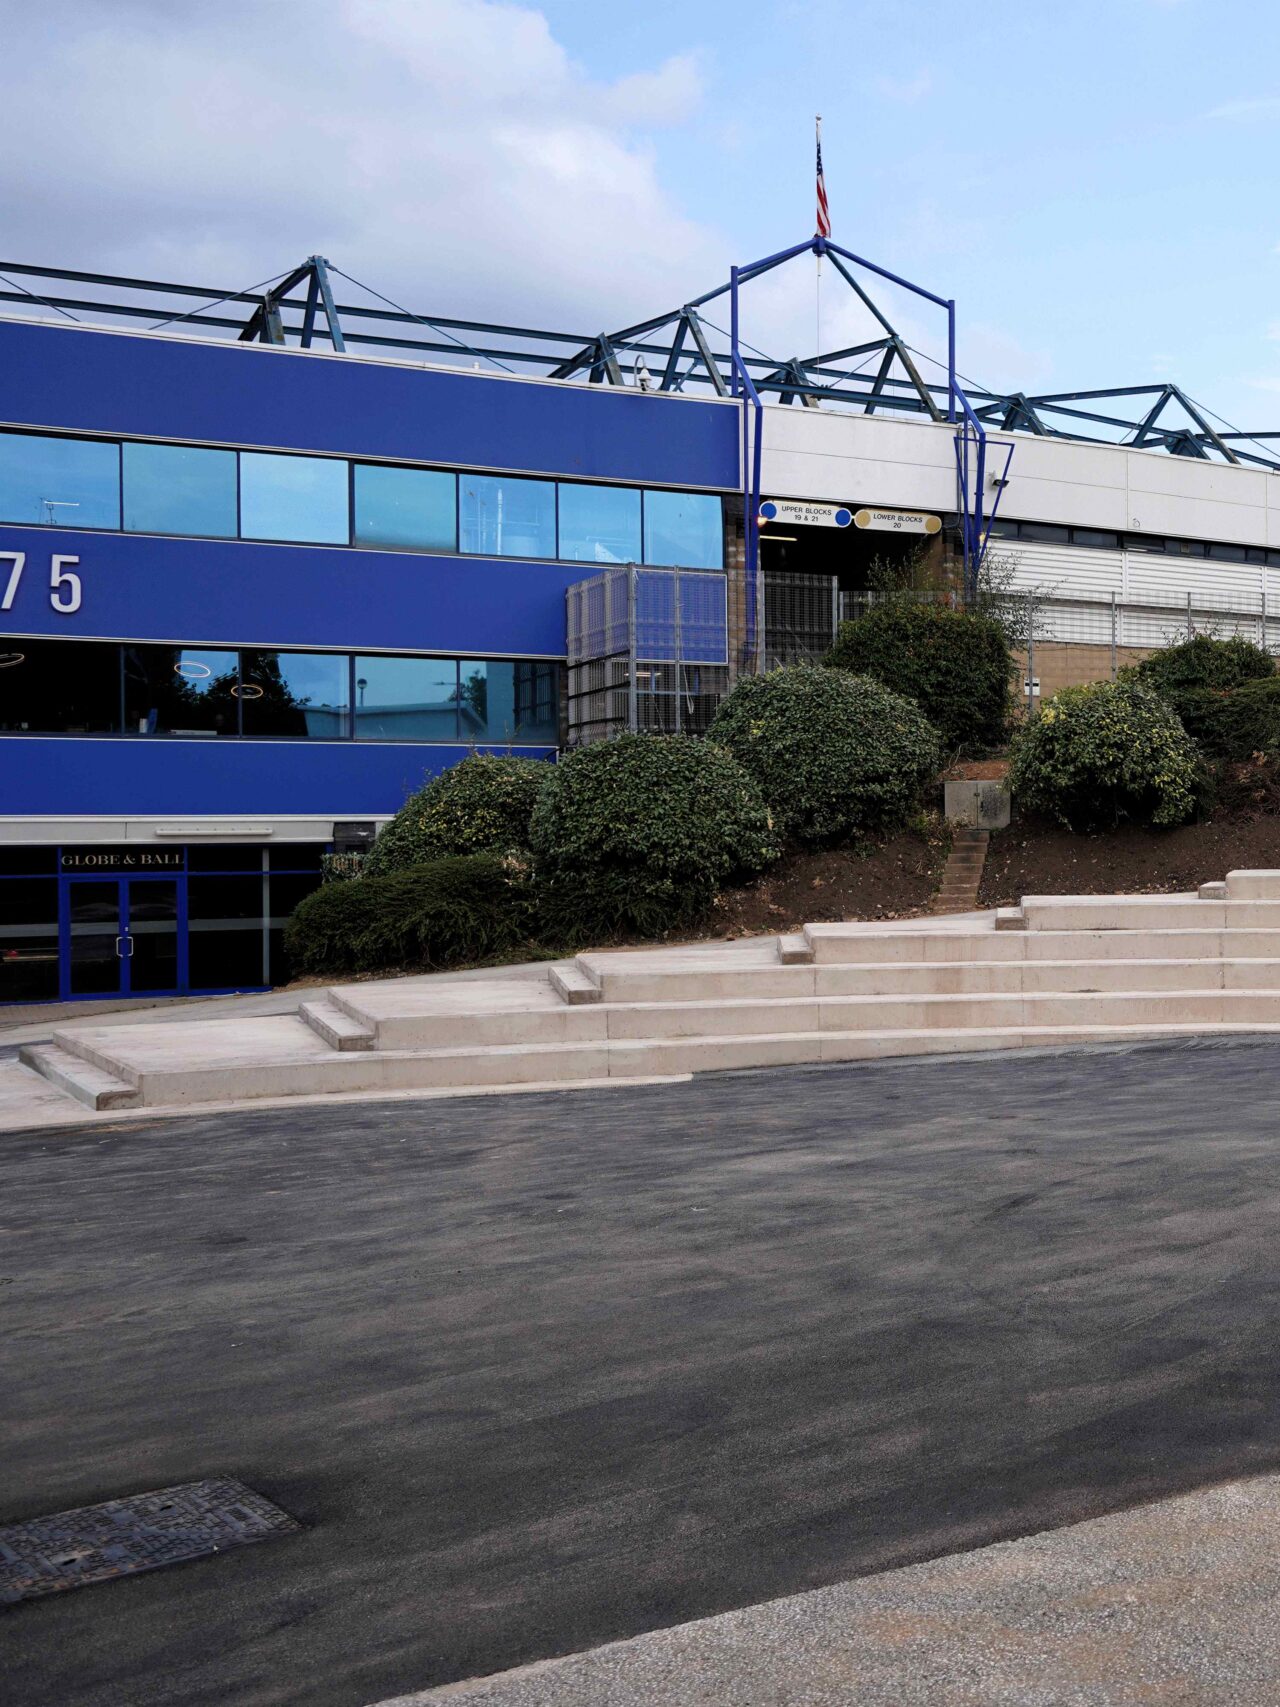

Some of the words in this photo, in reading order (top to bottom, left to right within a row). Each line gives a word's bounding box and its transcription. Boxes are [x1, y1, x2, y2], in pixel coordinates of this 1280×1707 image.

[781, 505, 803, 513] UPPER
[805, 507, 832, 516] BLOCKS
[873, 513, 896, 521] LOWER
[897, 515, 923, 523] BLOCKS
[61, 854, 120, 866] GLOBE
[122, 853, 136, 865] &
[140, 853, 185, 865] BALL
